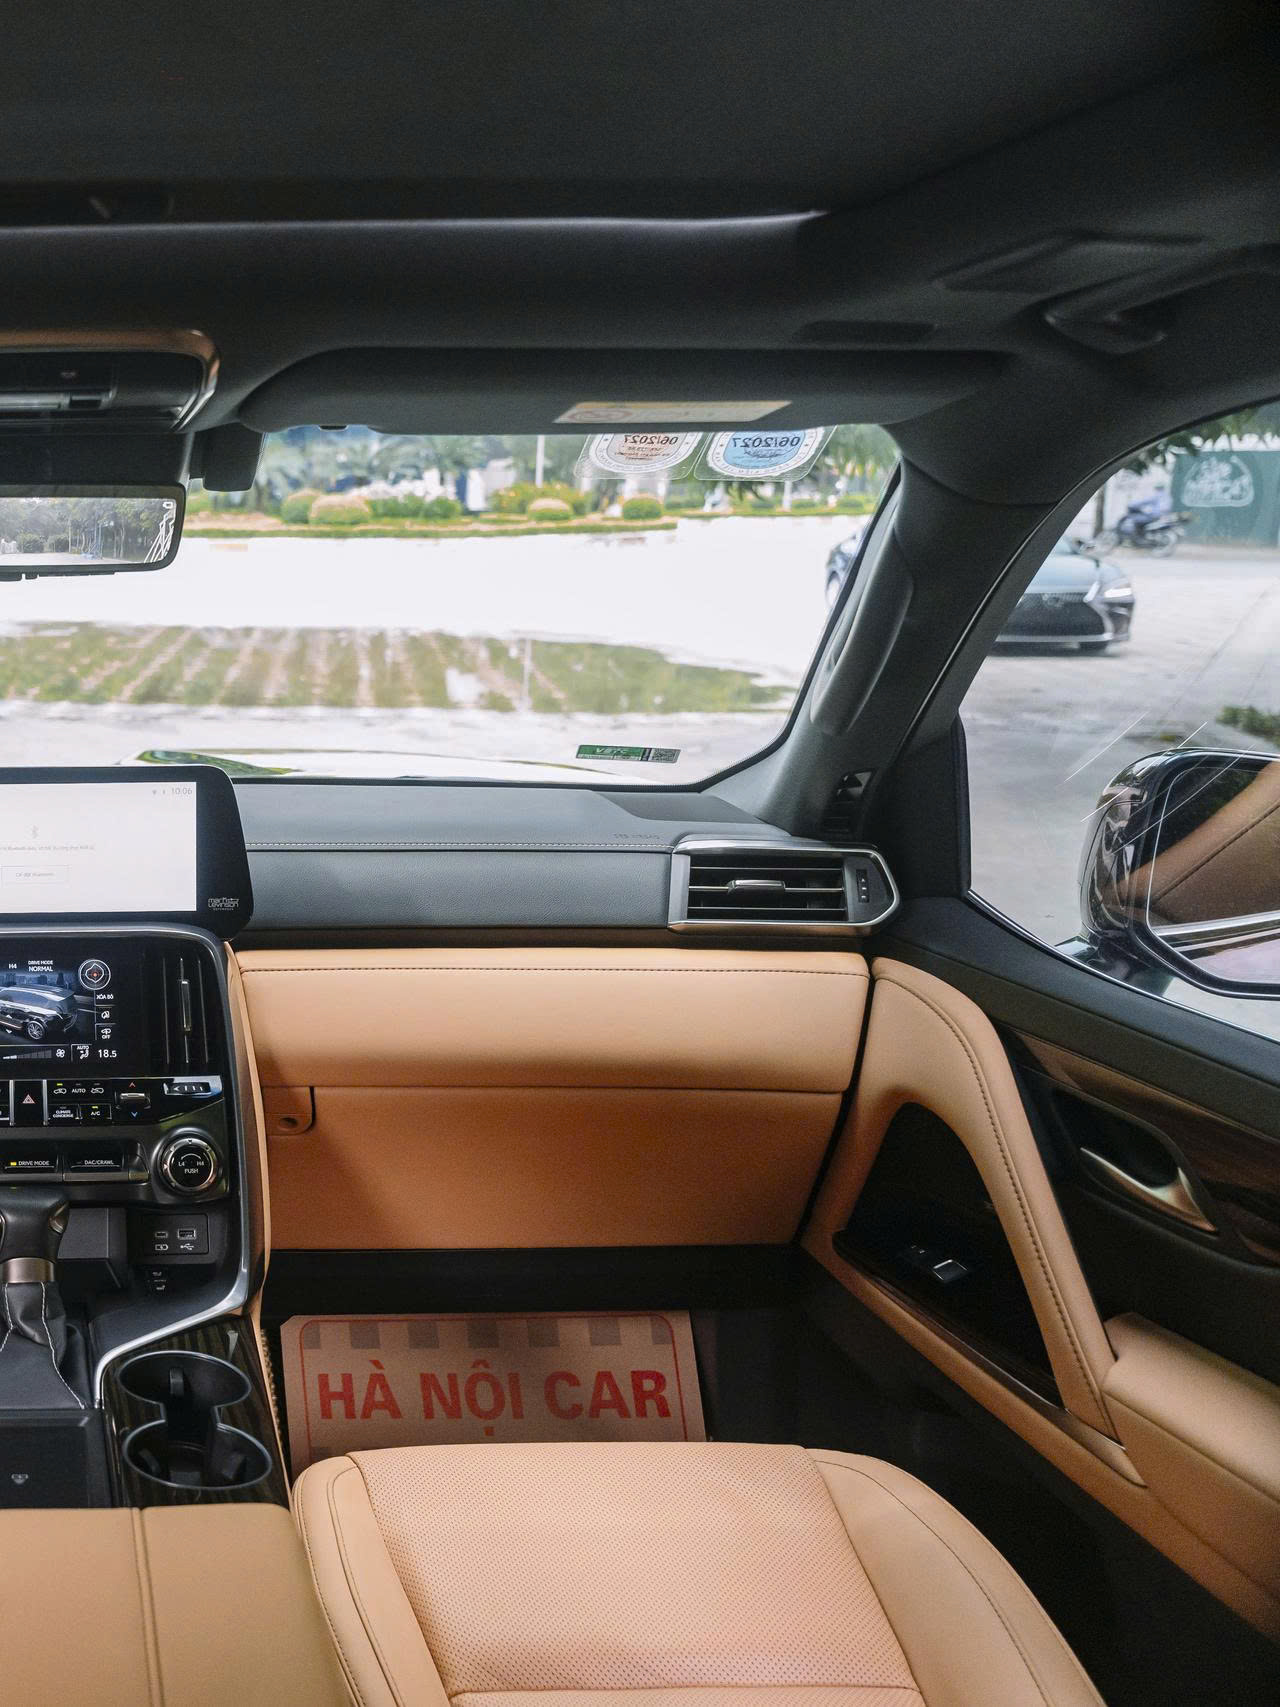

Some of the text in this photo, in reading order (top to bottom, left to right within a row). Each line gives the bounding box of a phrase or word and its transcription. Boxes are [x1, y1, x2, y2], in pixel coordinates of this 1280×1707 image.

[98, 1050, 117, 1058] 18.5
[318, 1359, 672, 1437] HÀ NỘI CAR
